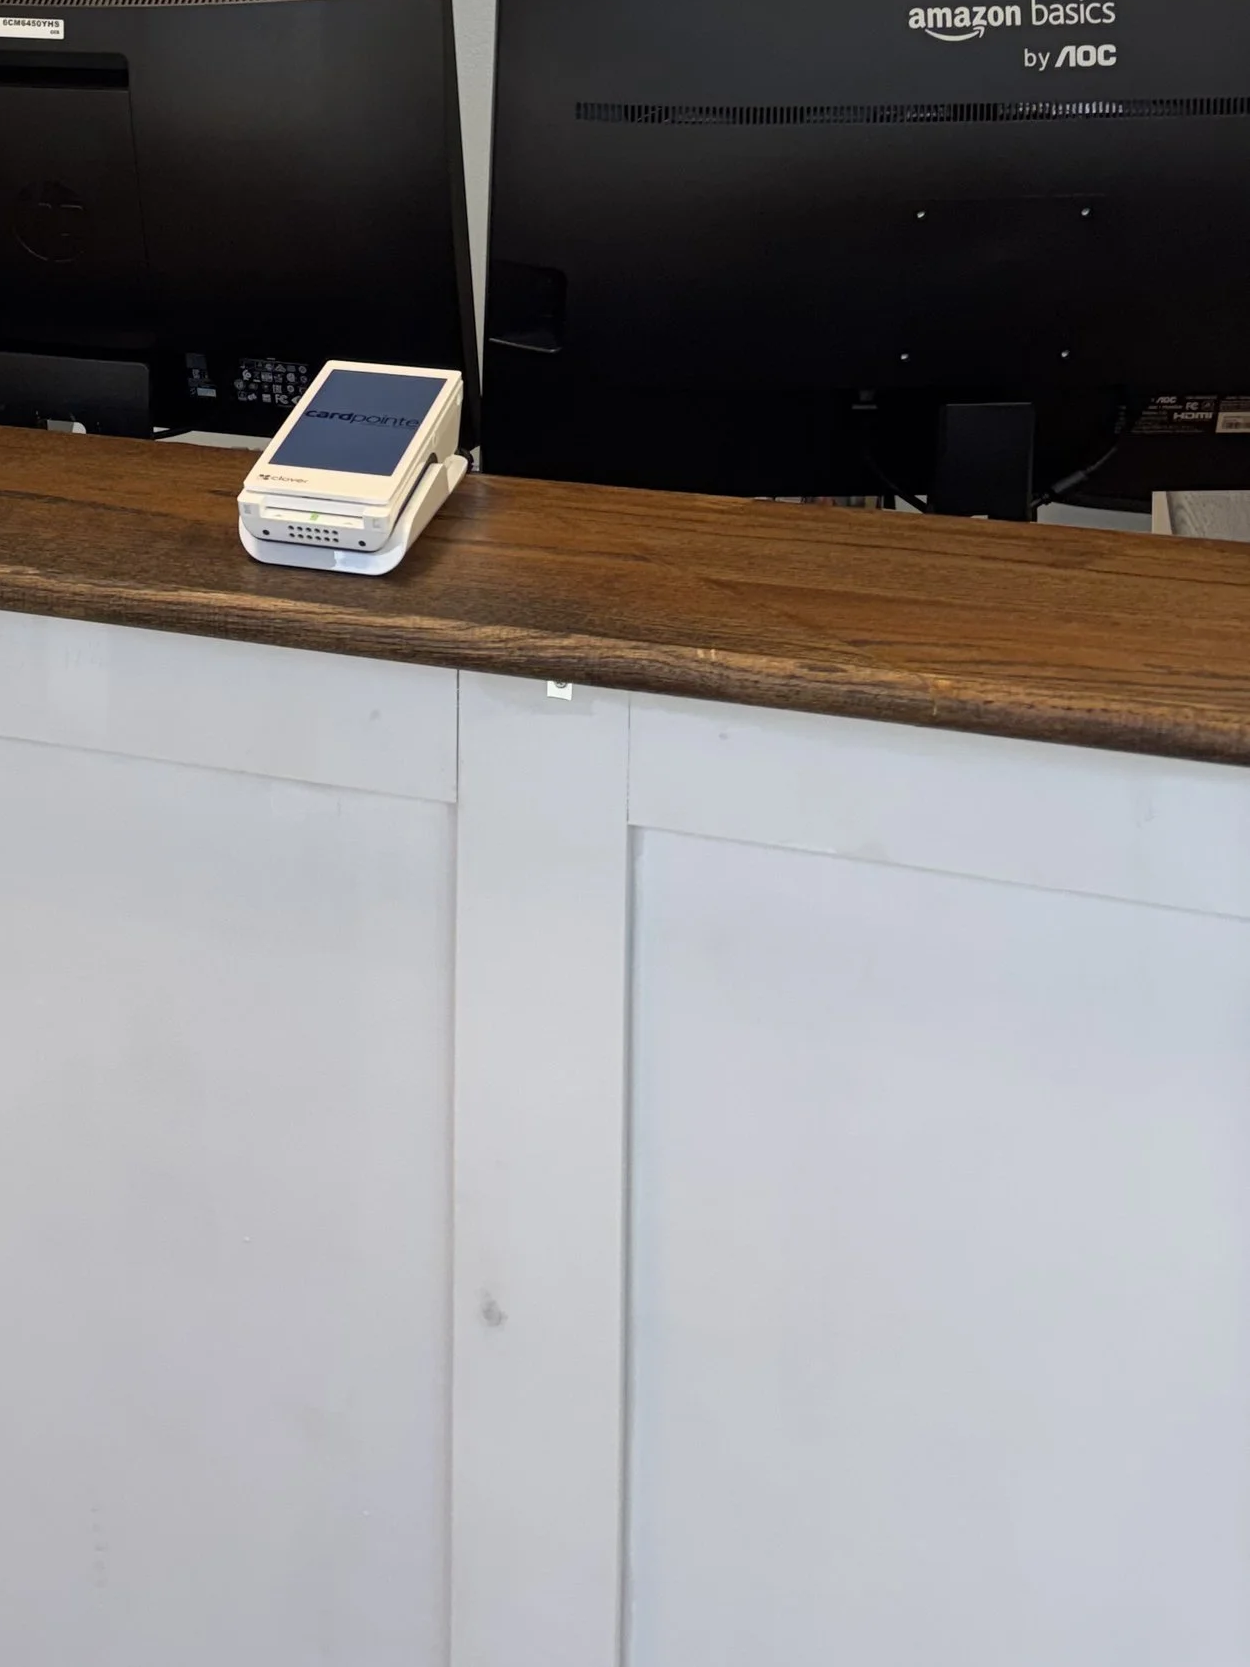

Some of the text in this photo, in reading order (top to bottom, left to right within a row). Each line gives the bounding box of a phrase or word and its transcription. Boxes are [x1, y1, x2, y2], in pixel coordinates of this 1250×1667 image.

[908, 4, 1022, 34] amazon
[1023, 43, 1117, 72] by AOC
[305, 410, 419, 427] cardpointe
